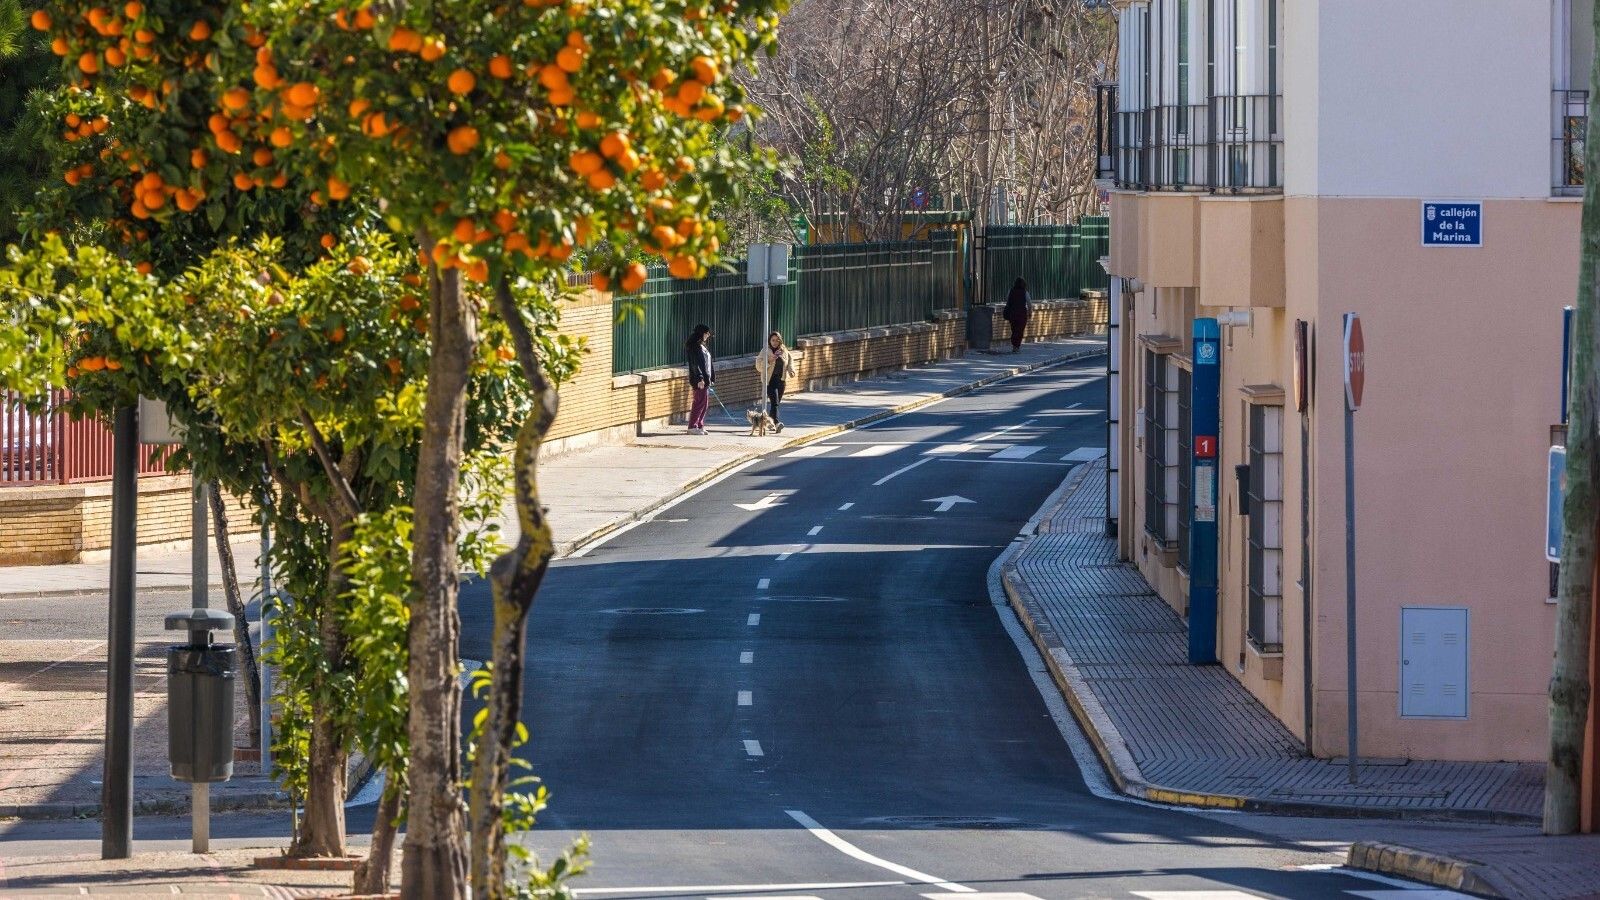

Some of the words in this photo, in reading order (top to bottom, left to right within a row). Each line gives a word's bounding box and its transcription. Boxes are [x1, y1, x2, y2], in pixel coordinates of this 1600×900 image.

[1440, 208, 1477, 219] callejón
[1439, 220, 1453, 230] de
[1455, 220, 1465, 230] la
[1432, 232, 1471, 242] Marina
[1349, 352, 1364, 372] STOP
[1201, 440, 1208, 452] 1
